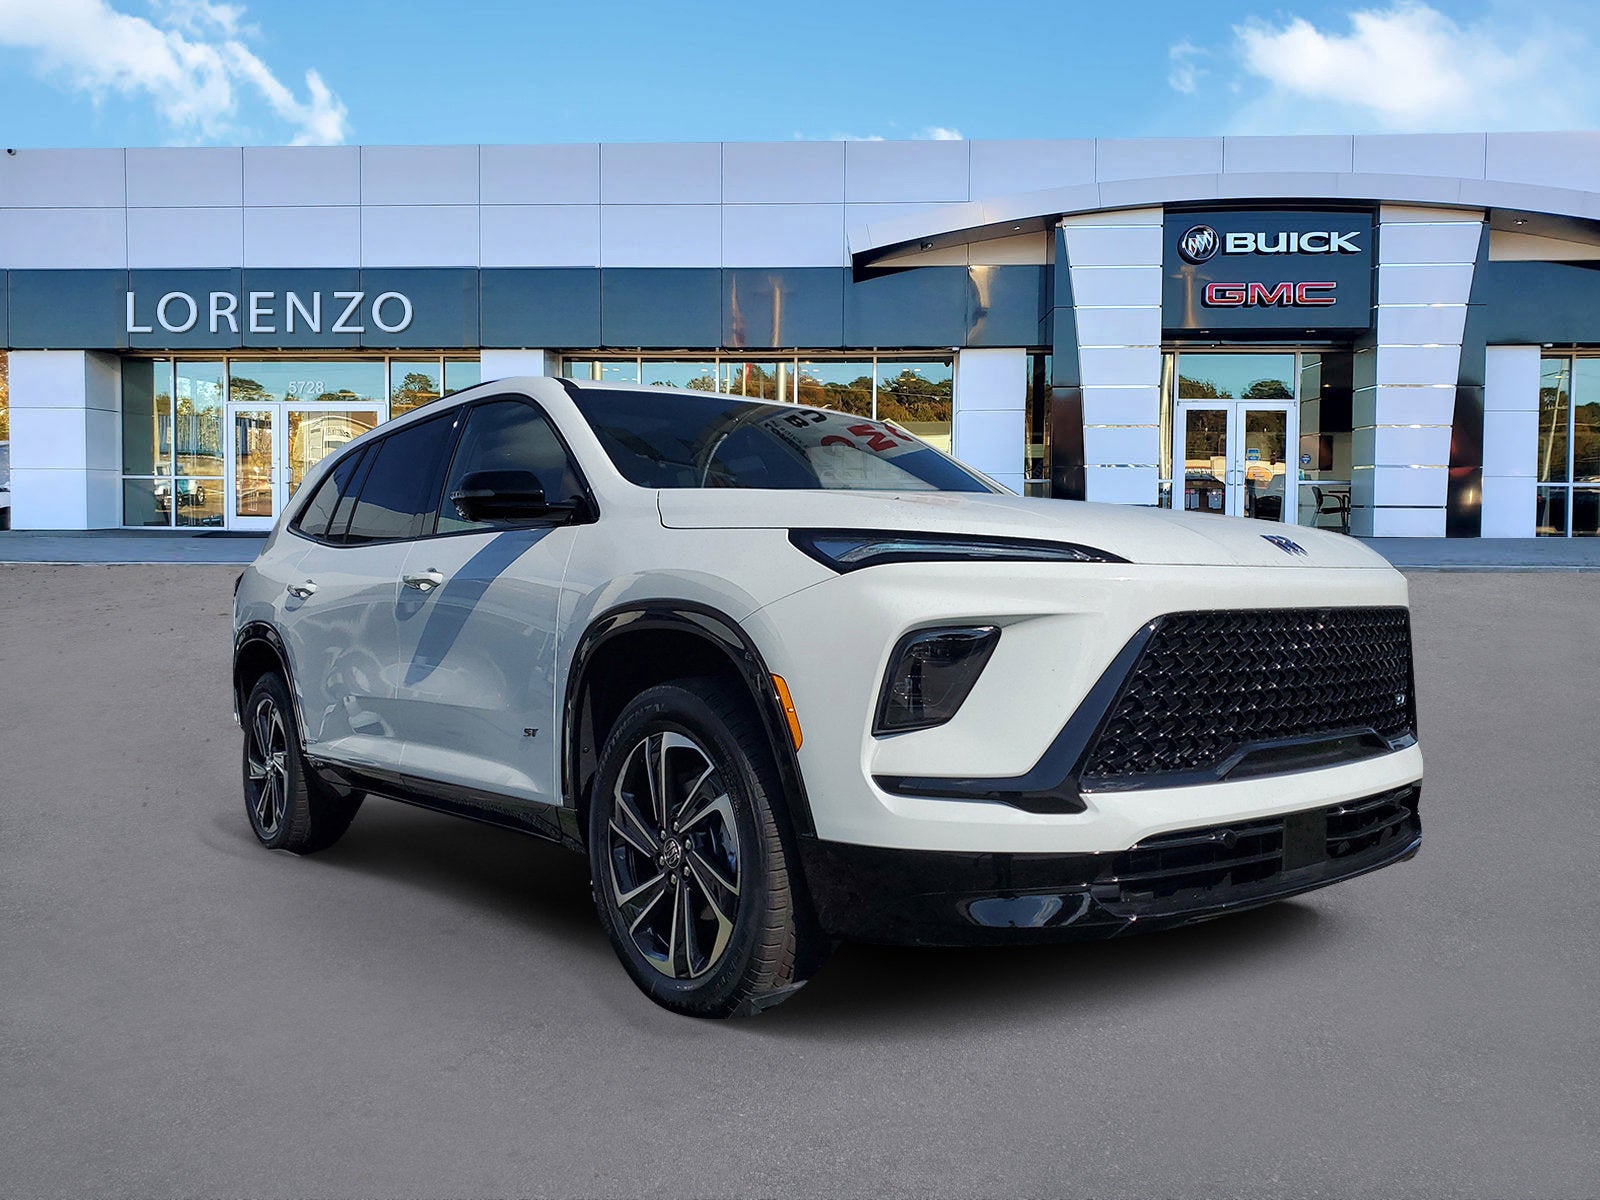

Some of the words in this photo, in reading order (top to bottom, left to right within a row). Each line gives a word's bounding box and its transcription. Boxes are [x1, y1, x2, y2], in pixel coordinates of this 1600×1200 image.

[1225, 231, 1362, 253] BUICK
[1206, 282, 1337, 305] GMC
[126, 291, 414, 333] LORENZO
[288, 381, 325, 394] 5728
[523, 728, 539, 738] ST
